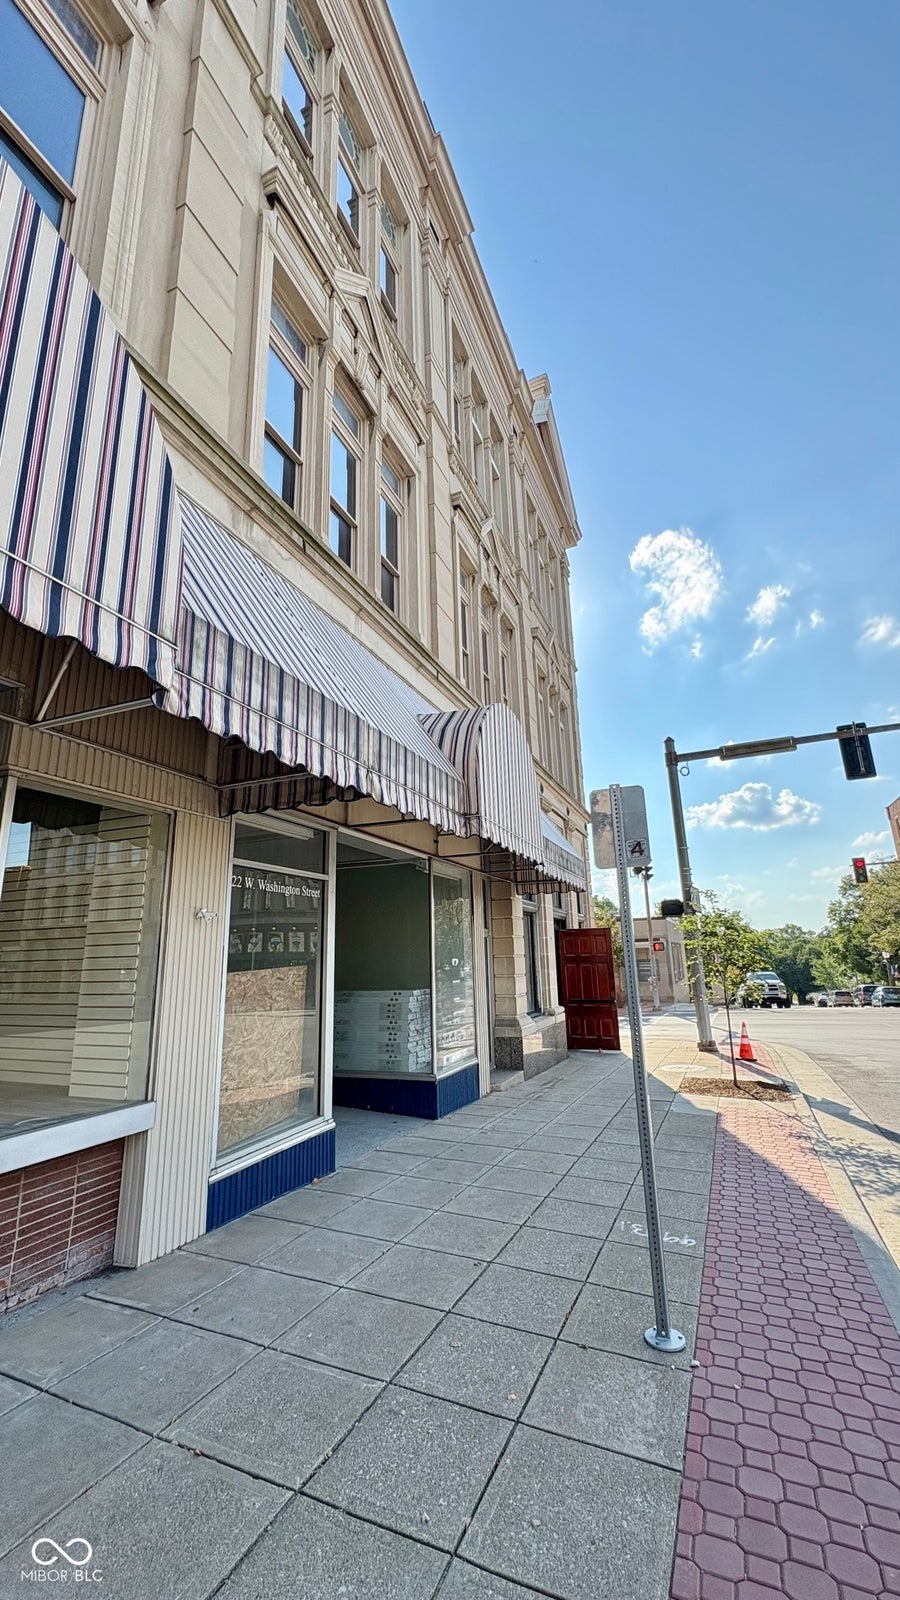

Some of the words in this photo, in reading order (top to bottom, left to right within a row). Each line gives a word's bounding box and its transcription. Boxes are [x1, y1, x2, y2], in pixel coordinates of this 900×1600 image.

[244, 876, 256, 890] W.
[258, 878, 301, 897] Washington
[301, 885, 321, 898] Street
